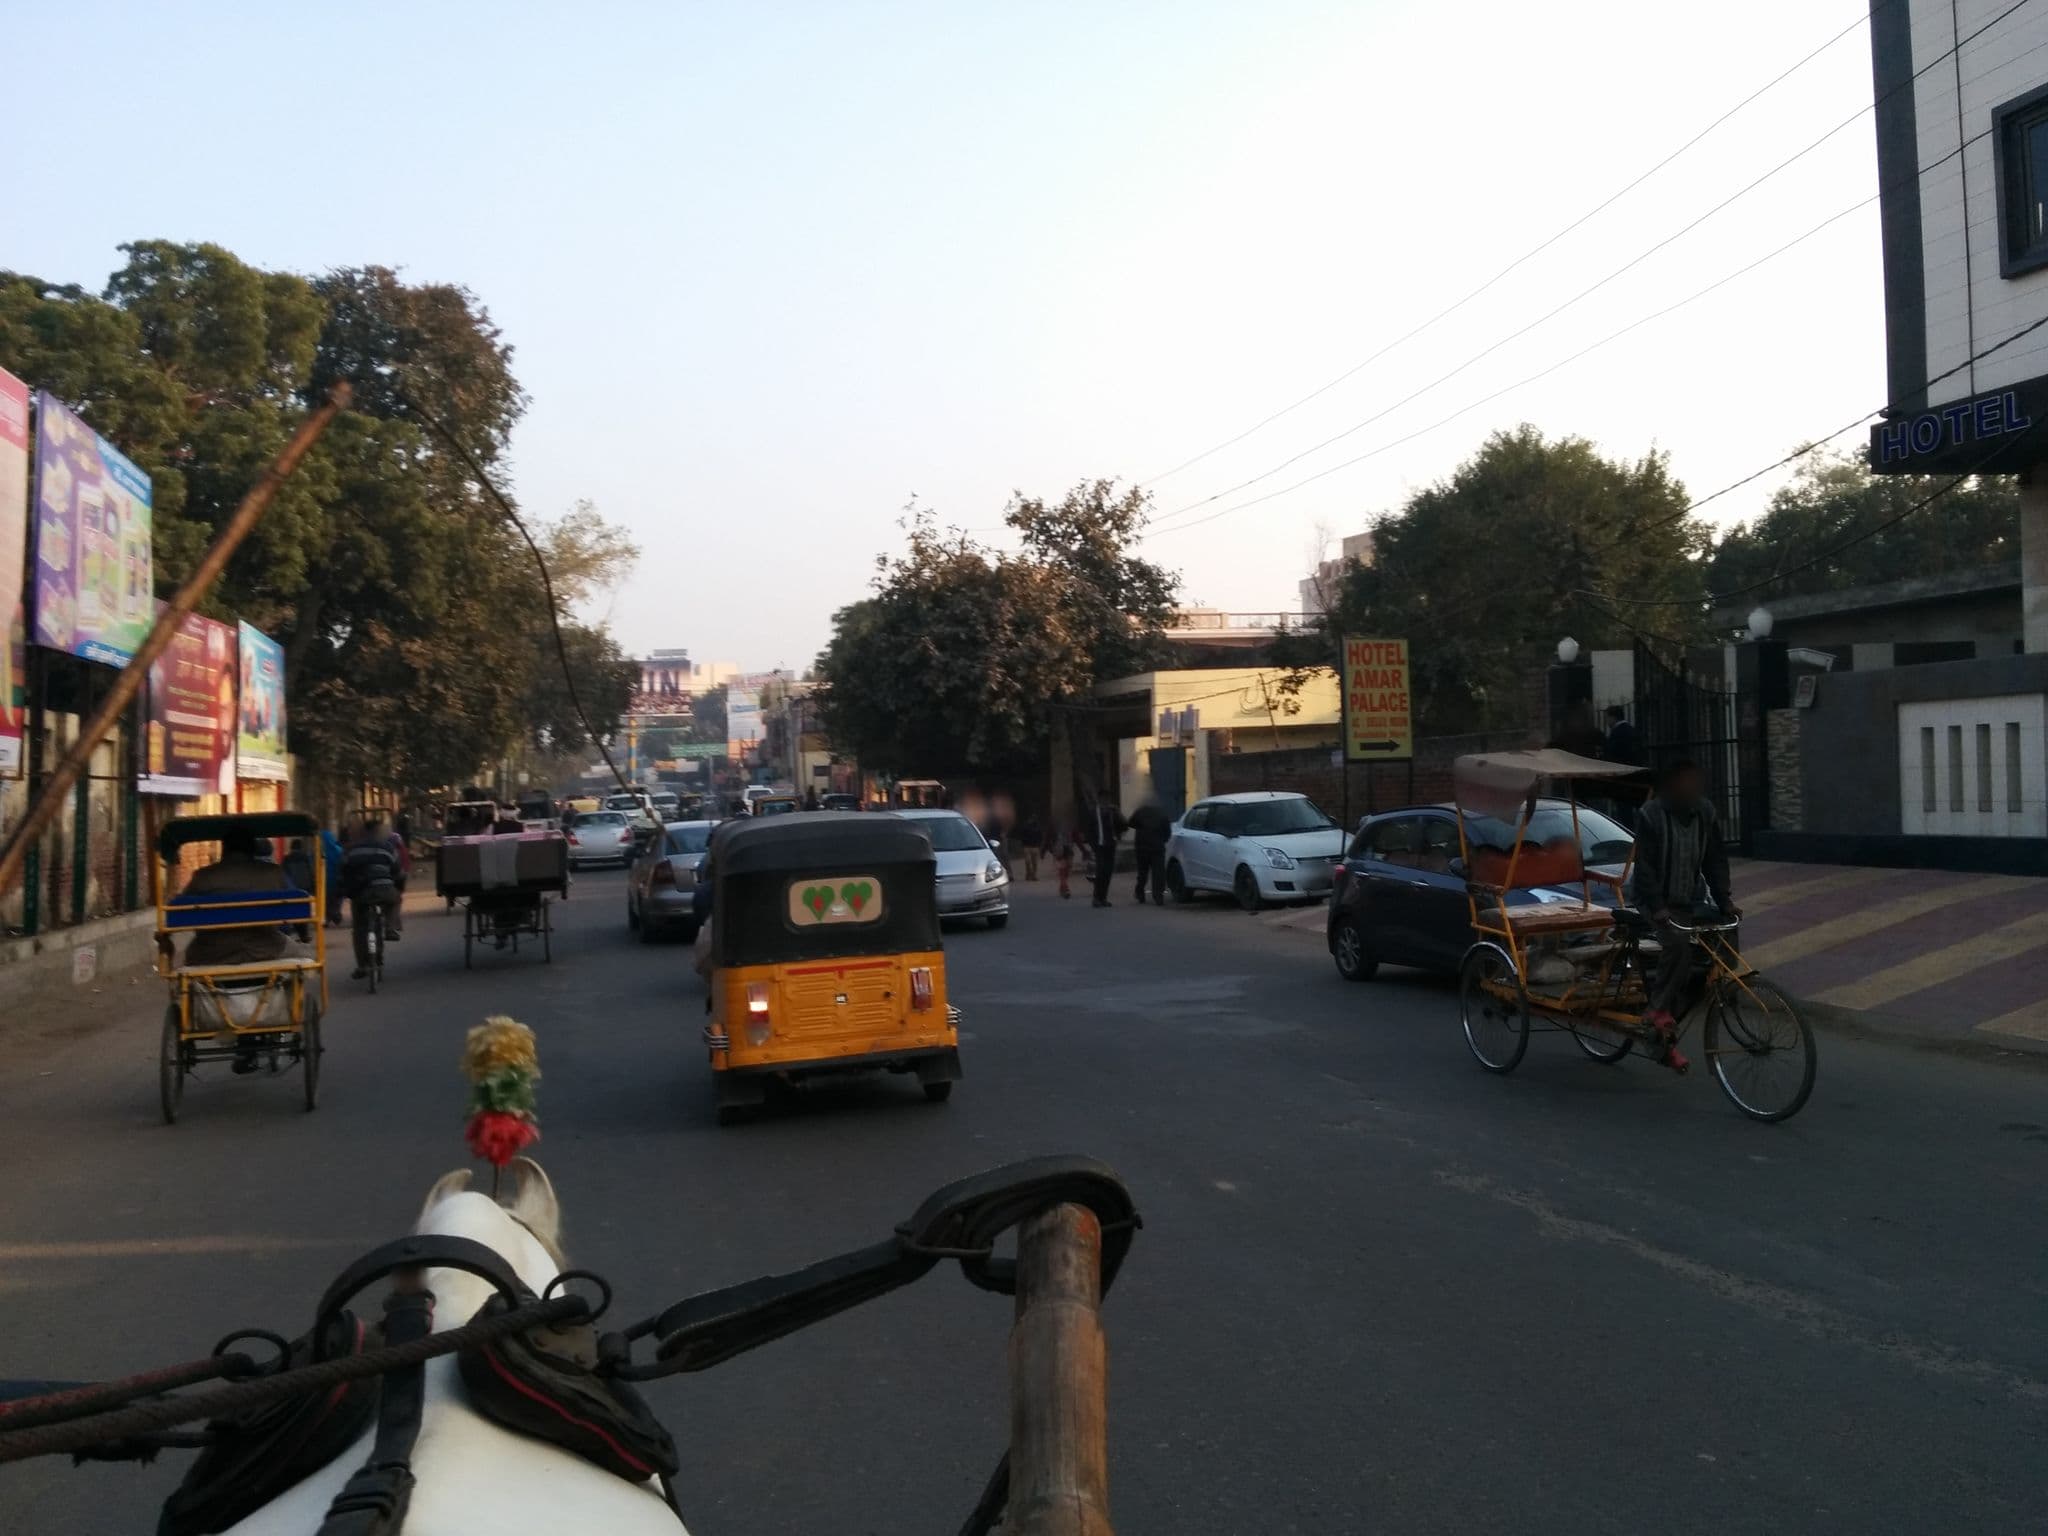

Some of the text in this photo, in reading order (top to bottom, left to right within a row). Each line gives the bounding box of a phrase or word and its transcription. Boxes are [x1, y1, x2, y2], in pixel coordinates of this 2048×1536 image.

[1881, 392, 2031, 464] HOTEL
[1348, 642, 1405, 665] HOTEL
[1353, 669, 1403, 688] AMAR
[1350, 693, 1408, 712] PALACE
